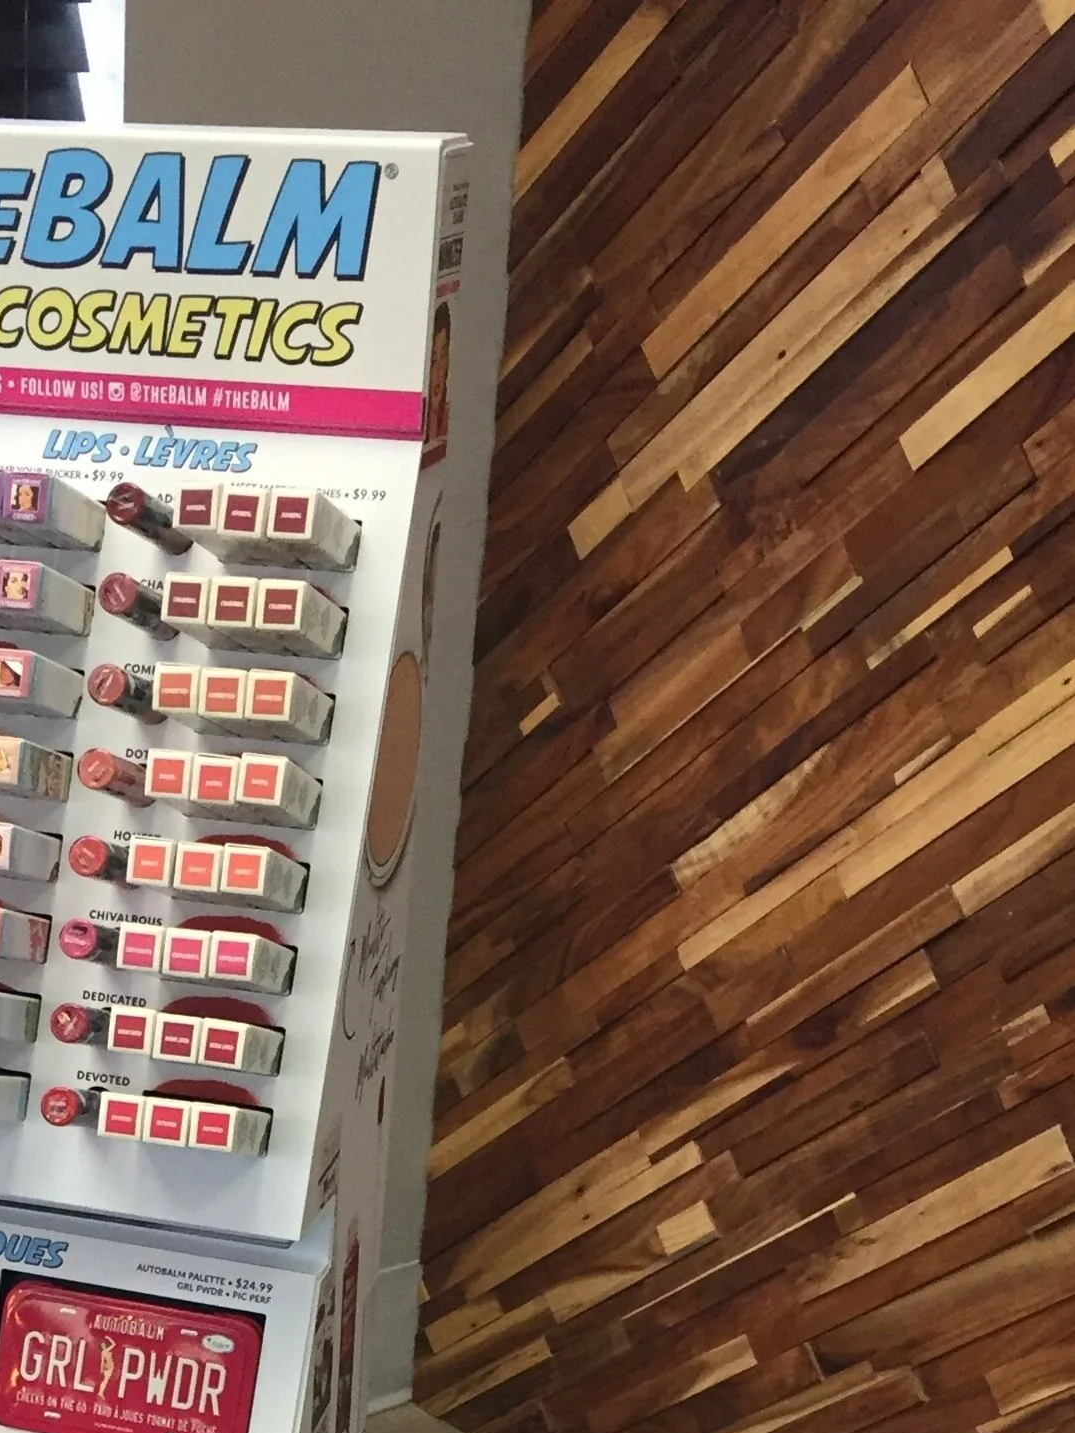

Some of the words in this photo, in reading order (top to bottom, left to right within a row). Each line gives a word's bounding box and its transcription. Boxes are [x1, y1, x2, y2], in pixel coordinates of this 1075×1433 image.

[21, 376, 76, 399] FOLLOW
[80, 381, 104, 401] US!
[130, 382, 206, 406] @THEBALM
[213, 388, 290, 411] #THEBALM
[42, 430, 117, 463] LIPS
[133, 425, 258, 474] LÈVRES
[92, 469, 124, 482] $9.99
[352, 488, 387, 501] $9.99
[89, 909, 163, 927] CHIVALROUS
[82, 990, 147, 1008] DEDICATED
[76, 1070, 131, 1087] DEVOTED
[137, 1263, 186, 1278] AUTOBALM
[188, 1271, 226, 1285] PALETTE
[236, 1278, 273, 1293] $24.99
[177, 1282, 194, 1292] GRL
[196, 1285, 224, 1296] PWDR
[233, 1290, 247, 1300] PIC
[249, 1294, 271, 1304] PERF
[94, 1314, 165, 1341] AUTOBALM
[21, 1330, 95, 1393] GRL
[118, 1347, 227, 1417] PWDR
